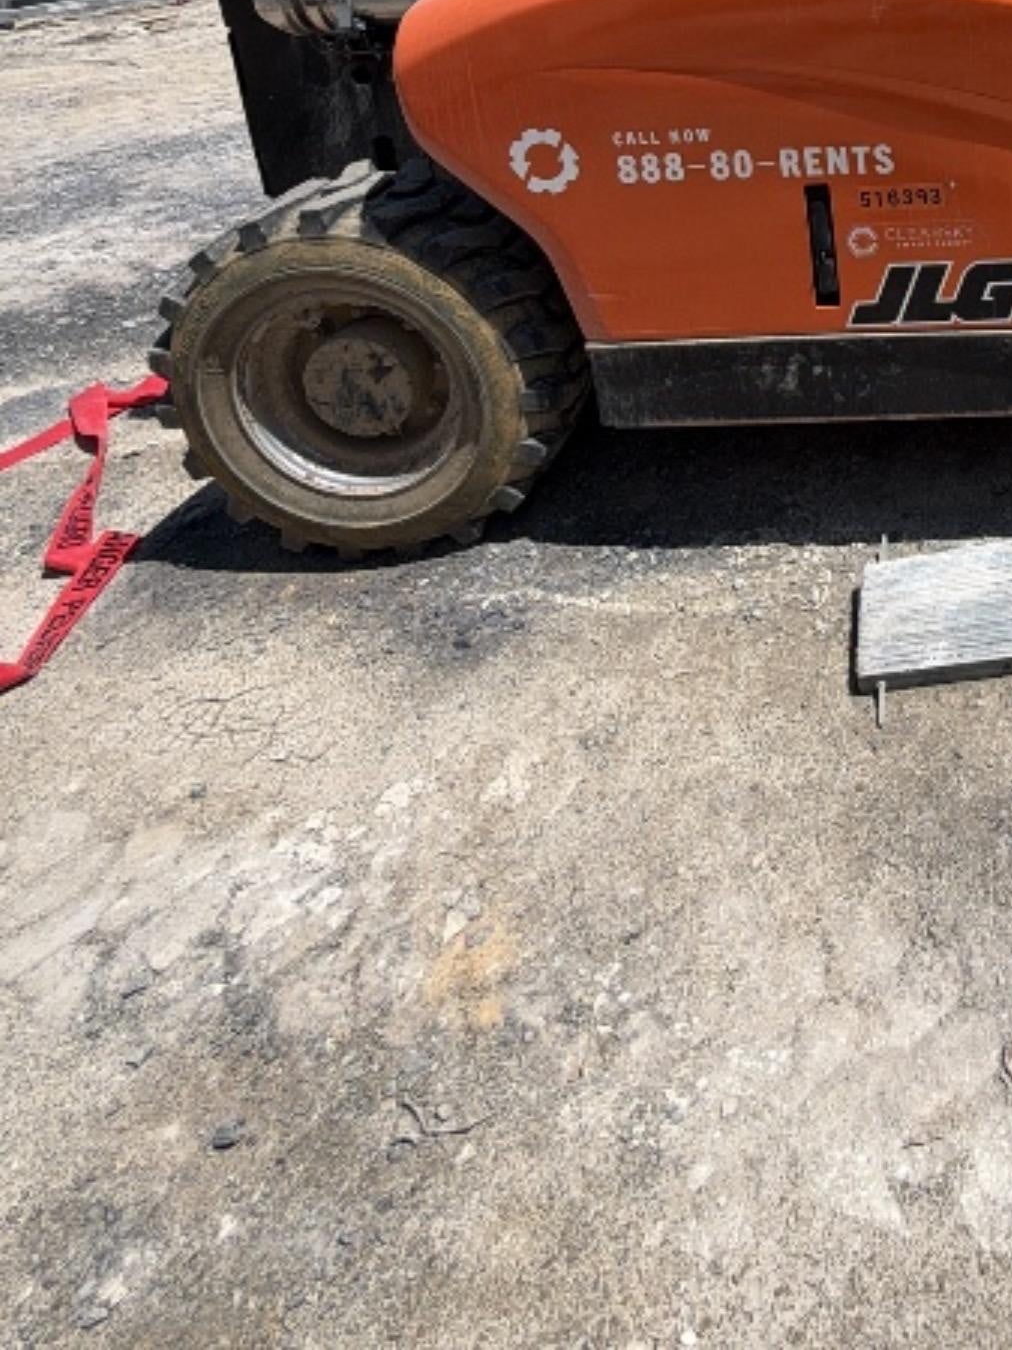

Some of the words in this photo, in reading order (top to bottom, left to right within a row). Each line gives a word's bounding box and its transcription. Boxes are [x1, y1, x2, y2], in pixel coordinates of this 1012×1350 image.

[611, 131, 661, 147] CALL
[668, 128, 711, 145] NOW
[616, 143, 896, 185] 888-80-RENTS
